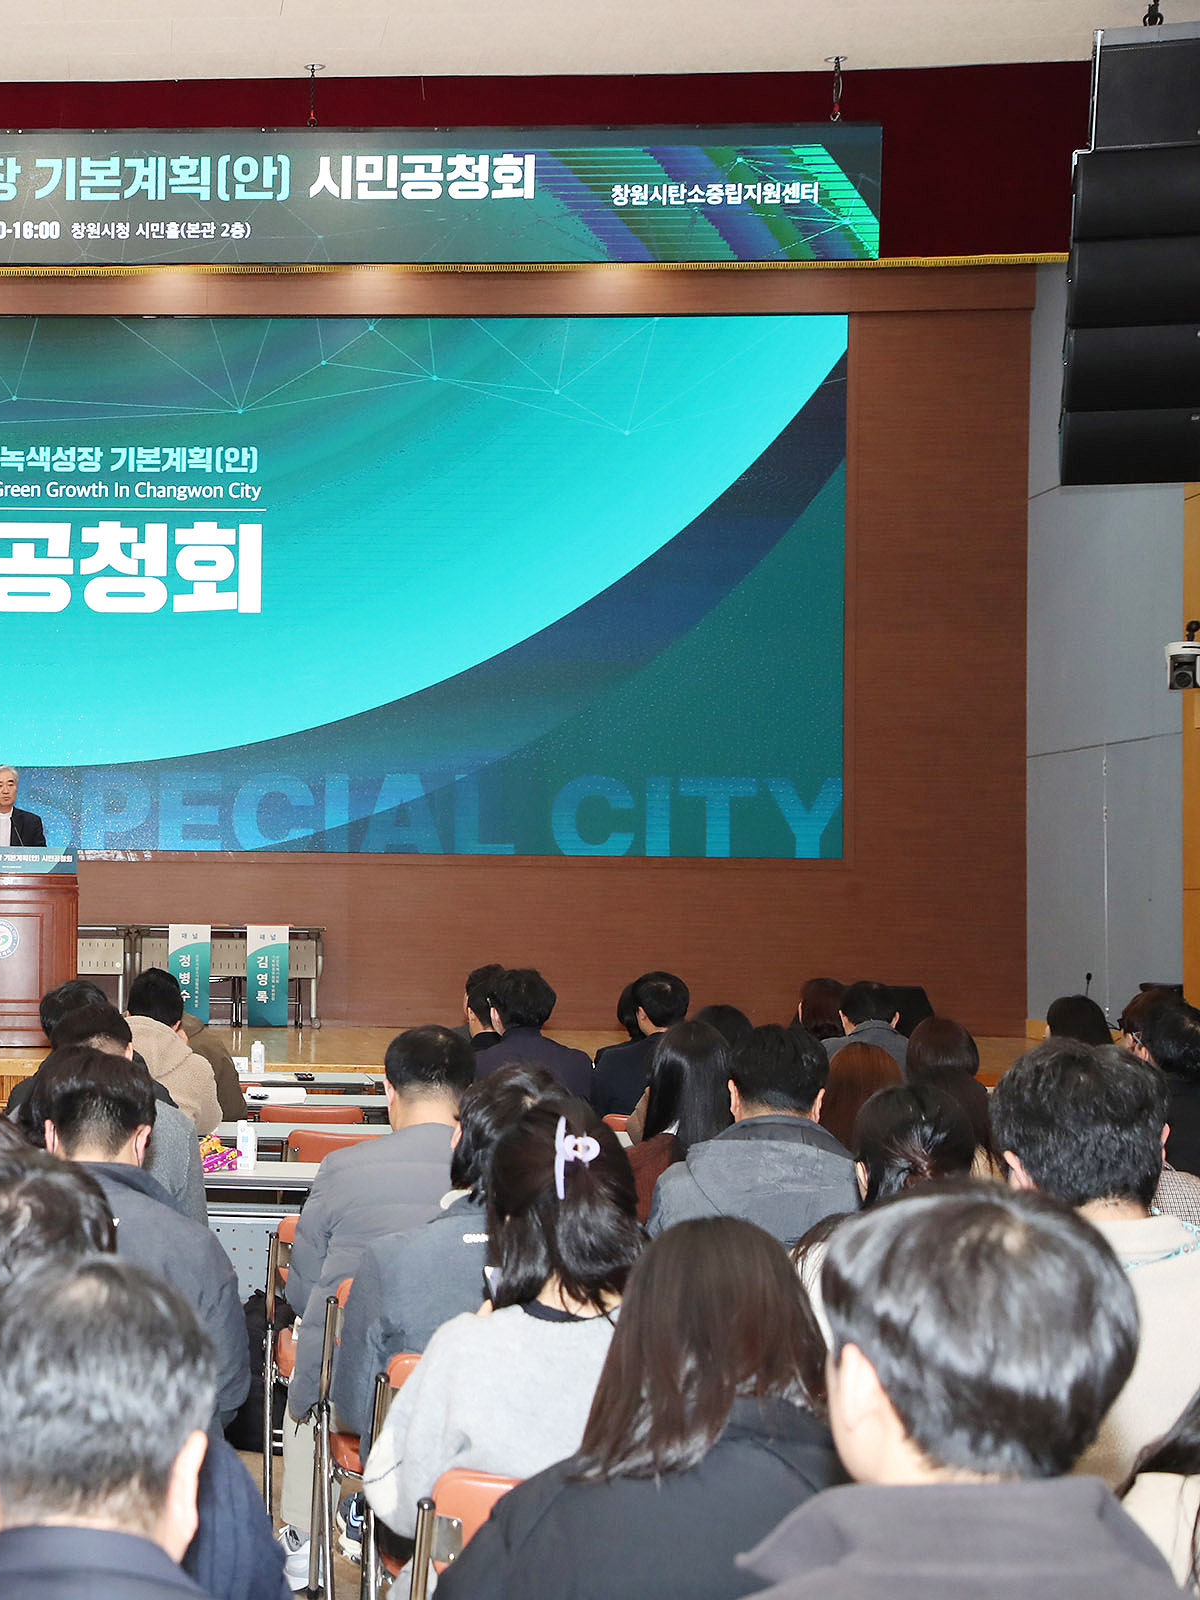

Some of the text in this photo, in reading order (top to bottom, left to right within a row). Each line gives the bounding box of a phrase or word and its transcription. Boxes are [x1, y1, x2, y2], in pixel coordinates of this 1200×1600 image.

[34, 155, 291, 202] 기본계획(안)
[309, 153, 536, 201] 시민공청회
[611, 181, 819, 206] 창원시탄소중립지원센터
[71, 221, 130, 240] 창원시청
[111, 446, 258, 474] 기본계획(안)
[46, 481, 109, 498] Growth
[114, 482, 130, 498] In
[134, 481, 224, 502] Changwon
[228, 482, 262, 502] City
[551, 775, 843, 859] CITY
